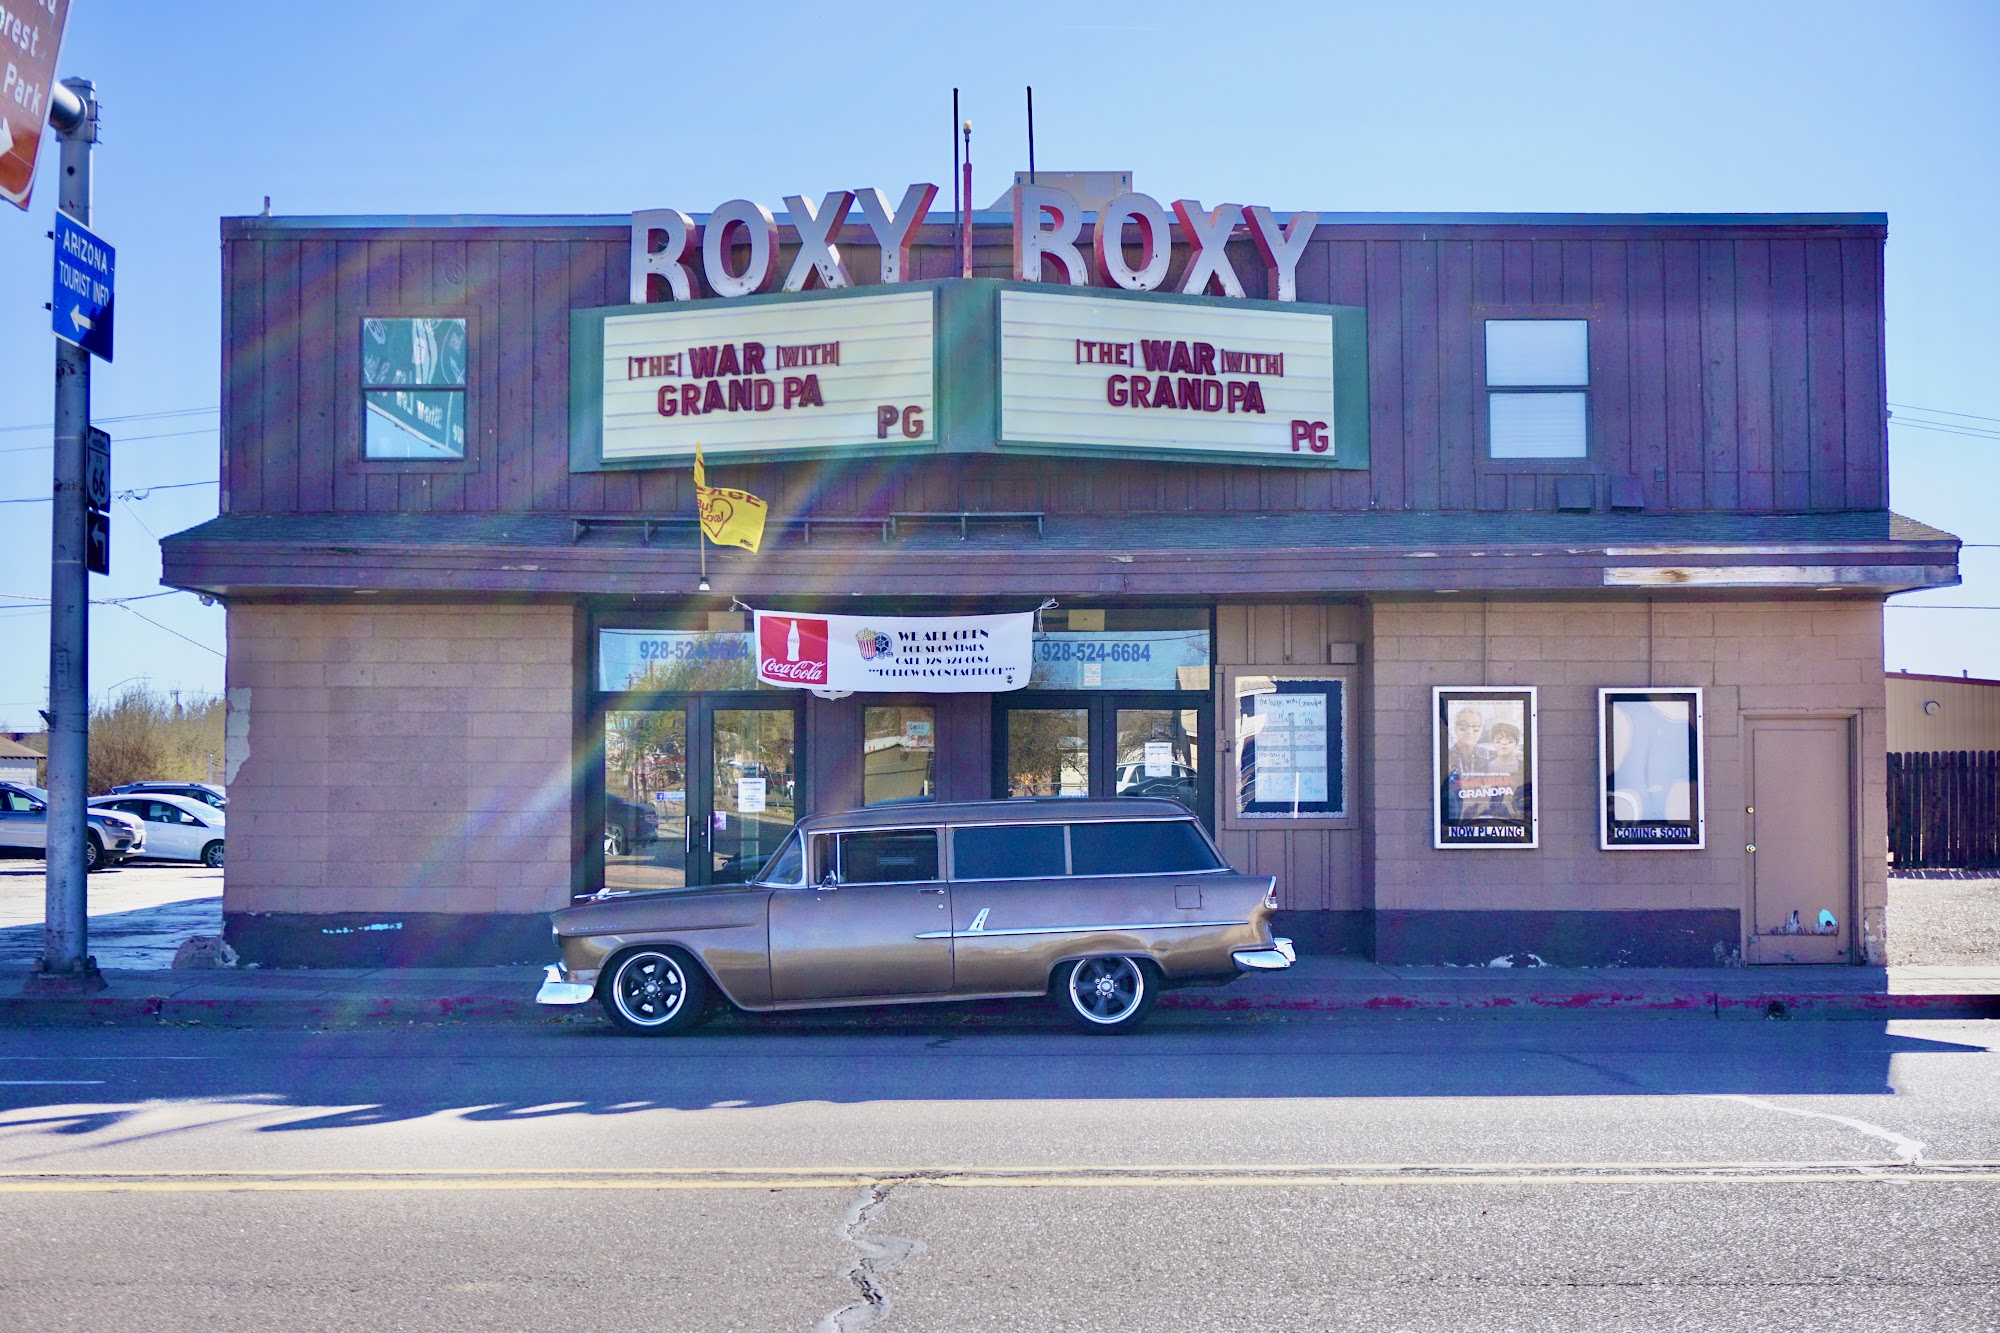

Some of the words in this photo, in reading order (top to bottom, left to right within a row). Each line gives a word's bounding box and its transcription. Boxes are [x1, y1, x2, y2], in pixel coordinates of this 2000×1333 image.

[3, 62, 42, 116] Park
[63, 229, 108, 275] ARIZONA
[630, 183, 939, 303] ROXY
[1013, 184, 1321, 302] ROXY
[59, 260, 91, 299] TOURIST
[93, 281, 109, 308] INFO
[633, 355, 677, 378] THE
[688, 341, 765, 379] WAR
[778, 342, 837, 368] WITH
[1081, 341, 1129, 366] THE
[1141, 339, 1216, 375] WAR
[1224, 351, 1282, 376] WITH
[1107, 374, 1266, 414] GRANDPA
[876, 405, 924, 439] PG
[1291, 420, 1329, 453] PG
[92, 467, 105, 497] 66
[697, 499, 714, 513] Buy
[898, 631, 919, 641] WE
[923, 630, 950, 641] ARE
[953, 629, 989, 640] OPEN
[902, 645, 922, 653] FOR
[926, 643, 984, 653] SHOWTIMES
[640, 641, 749, 660] 928-524-6684
[895, 657, 920, 665] CALL
[924, 655, 989, 665] 928-524-6684
[1042, 643, 1151, 662] 928-524-6684
[762, 658, 826, 680] Coca-Cola
[922, 668, 935, 677] US
[937, 668, 951, 676] ON
[1458, 787, 1514, 799] GRANDPA
[1451, 826, 1474, 837] NOW
[1479, 826, 1523, 838] PLAYING
[1616, 827, 1657, 838] COMING
[1660, 827, 1688, 838] SOON
